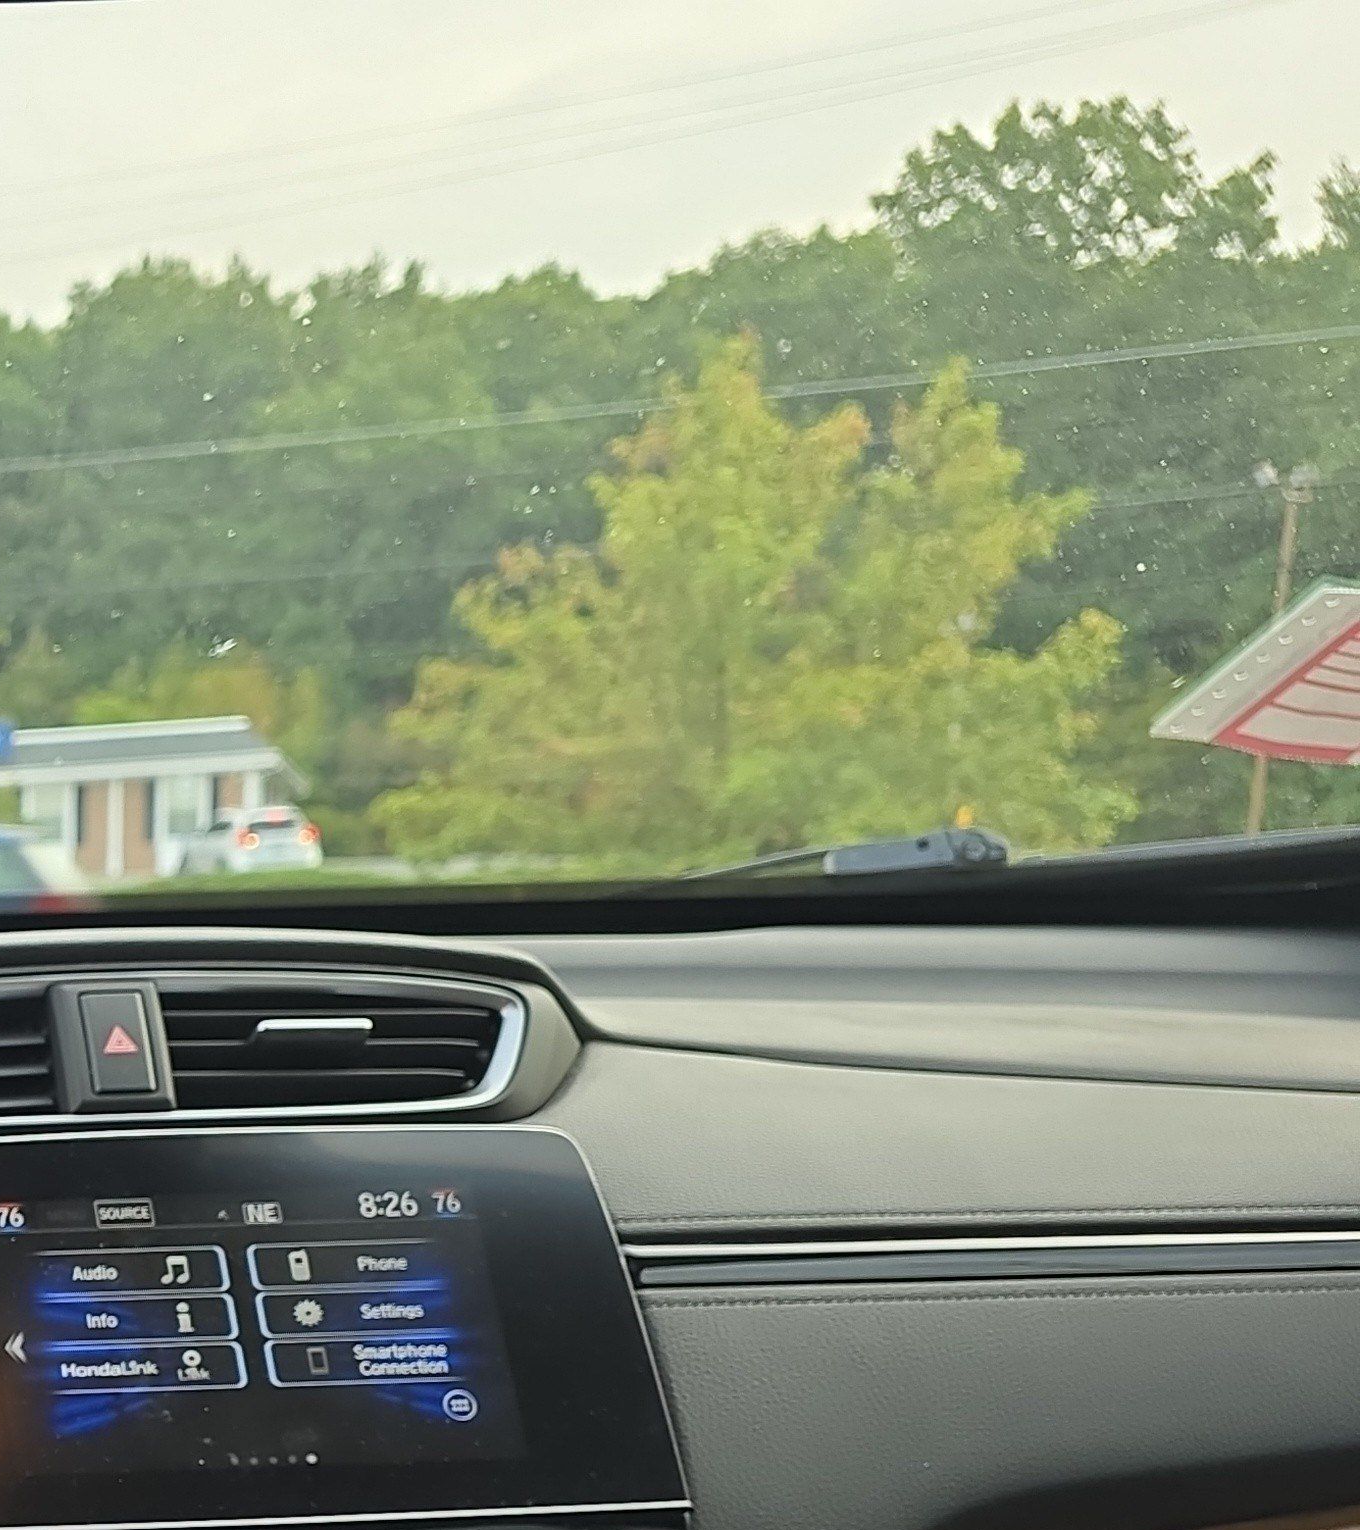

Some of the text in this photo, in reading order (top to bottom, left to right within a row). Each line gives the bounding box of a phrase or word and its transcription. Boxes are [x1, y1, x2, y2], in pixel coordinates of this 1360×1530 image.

[358, 1191, 418, 1218] 8:26
[432, 1191, 462, 1213] 76
[98, 1205, 149, 1222] SOURCE
[247, 1203, 278, 1222] NE
[72, 1263, 118, 1281] Audio
[356, 1254, 409, 1272] Phone
[359, 1302, 425, 1320] Settings
[86, 1312, 118, 1329] Info
[352, 1343, 448, 1361] Smartphone
[60, 1360, 159, 1379] HondaLink
[358, 1359, 449, 1377] Connection
